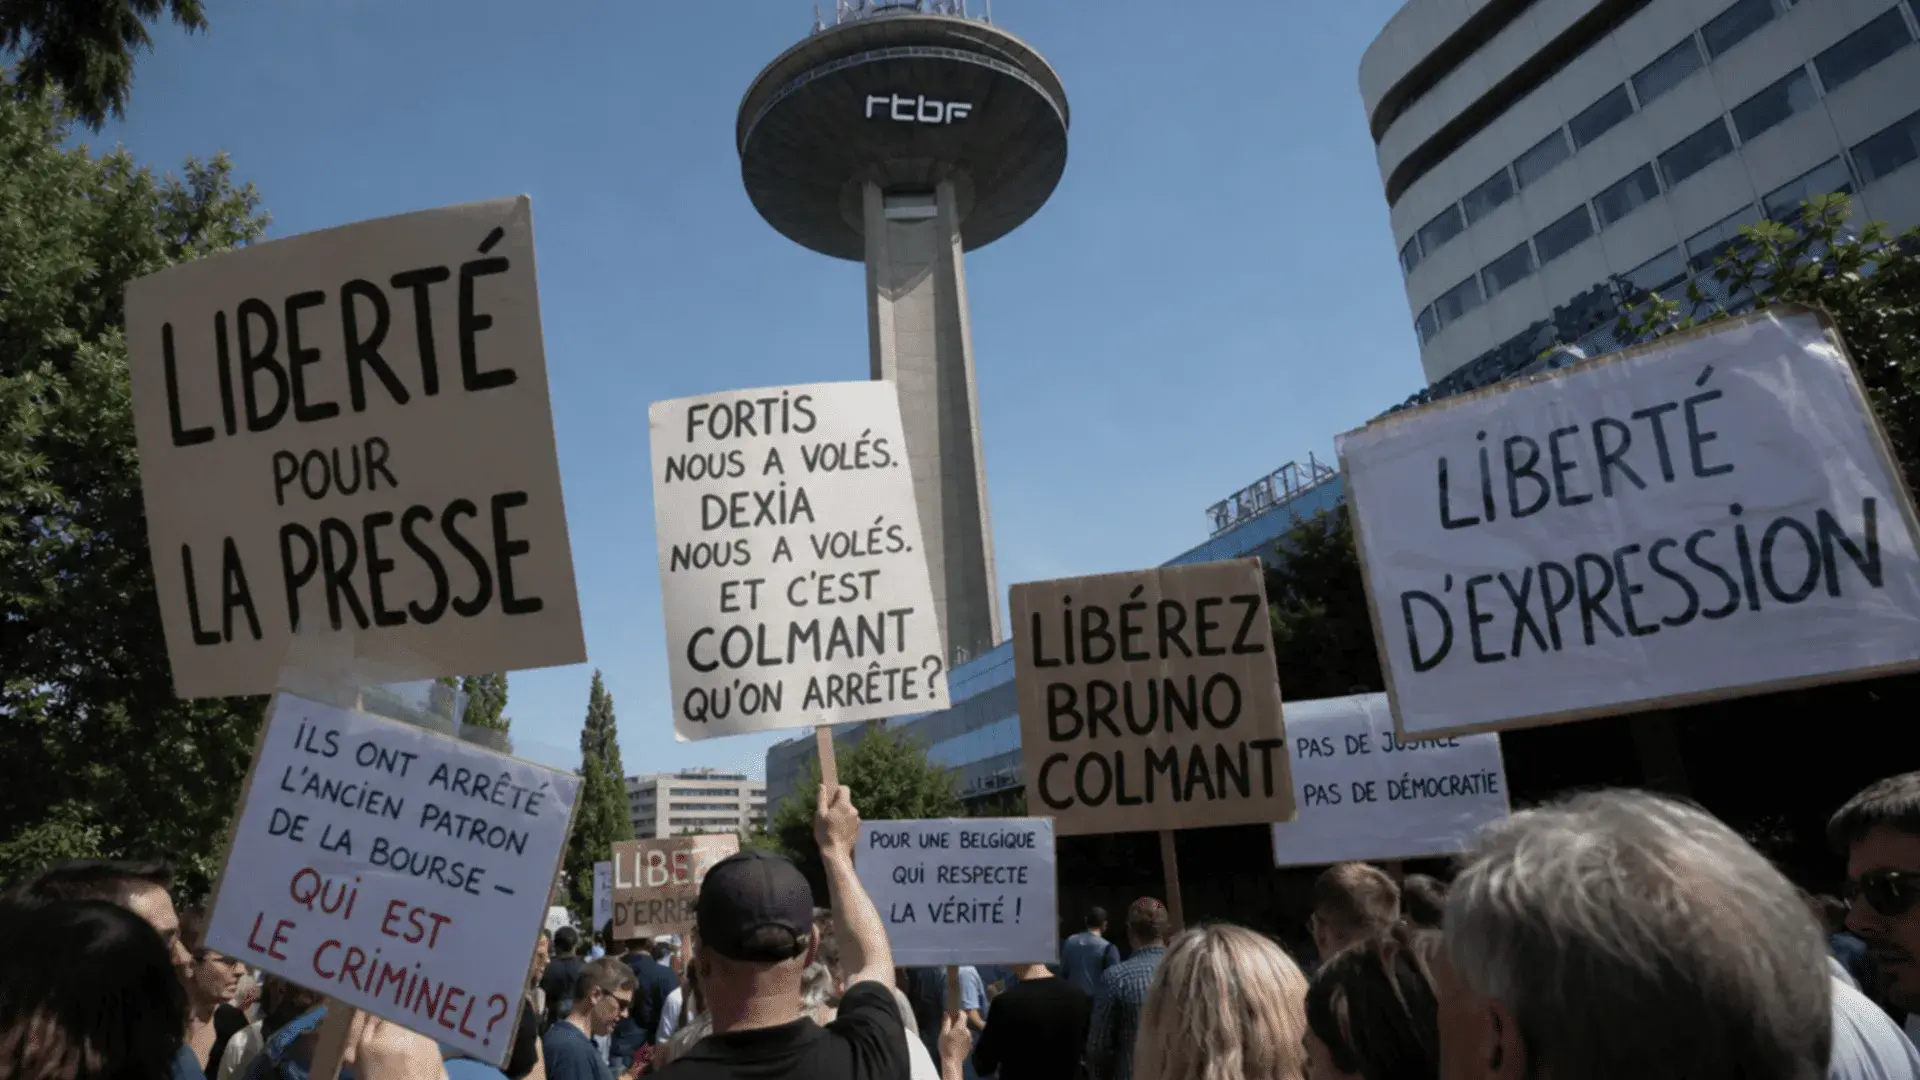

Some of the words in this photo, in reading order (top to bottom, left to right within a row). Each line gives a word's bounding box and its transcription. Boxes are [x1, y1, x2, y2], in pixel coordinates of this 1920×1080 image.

[162, 227, 517, 447] LIBERTÉ
[687, 391, 817, 442] FORTIS
[1438, 365, 1735, 530] LIBERTÉ
[273, 436, 398, 505] POUR
[665, 450, 745, 483] NOUS
[762, 447, 784, 476] A
[800, 428, 899, 473] VOLÉS.
[702, 481, 815, 531] DEXIA
[181, 536, 262, 645] LA
[280, 491, 543, 633] PRESSE
[670, 538, 751, 572] NOUS
[772, 536, 793, 563] A
[810, 515, 912, 560] VOLÉS.
[720, 578, 765, 613] ET
[787, 570, 880, 607] C'EST
[1400, 498, 1883, 673] D'EXPRESSION
[686, 607, 914, 672] COLMANT
[1032, 584, 1265, 668] LIBÉREZ
[683, 679, 783, 723] QU'ON
[1047, 673, 1242, 742] BRUNO
[294, 717, 340, 758] ILS
[356, 742, 418, 778] ONT
[428, 763, 550, 816] ARRÊTÉ
[1038, 738, 1283, 810] COLMANT
[1296, 736, 1336, 758] PAS
[1345, 732, 1369, 755] DE
[280, 766, 403, 819] L'ANCIEN
[420, 804, 529, 855] PATRON
[1303, 783, 1342, 807] PAS
[1351, 781, 1377, 803] DE
[1387, 768, 1499, 801] DÉMOCRATIE
[268, 808, 309, 841] DE
[319, 825, 352, 856] LA
[369, 837, 486, 895] BOURSE
[870, 831, 911, 849] POUR
[919, 832, 950, 849] UNE
[960, 829, 1036, 849] BELGIQUE
[892, 862, 924, 885] QUI
[937, 865, 1028, 885] RESPECTE
[247, 912, 296, 961] LE
[290, 867, 361, 920] QUI
[381, 900, 452, 949] EST
[890, 902, 916, 924] LA
[928, 895, 1004, 924] VÉRITÉ
